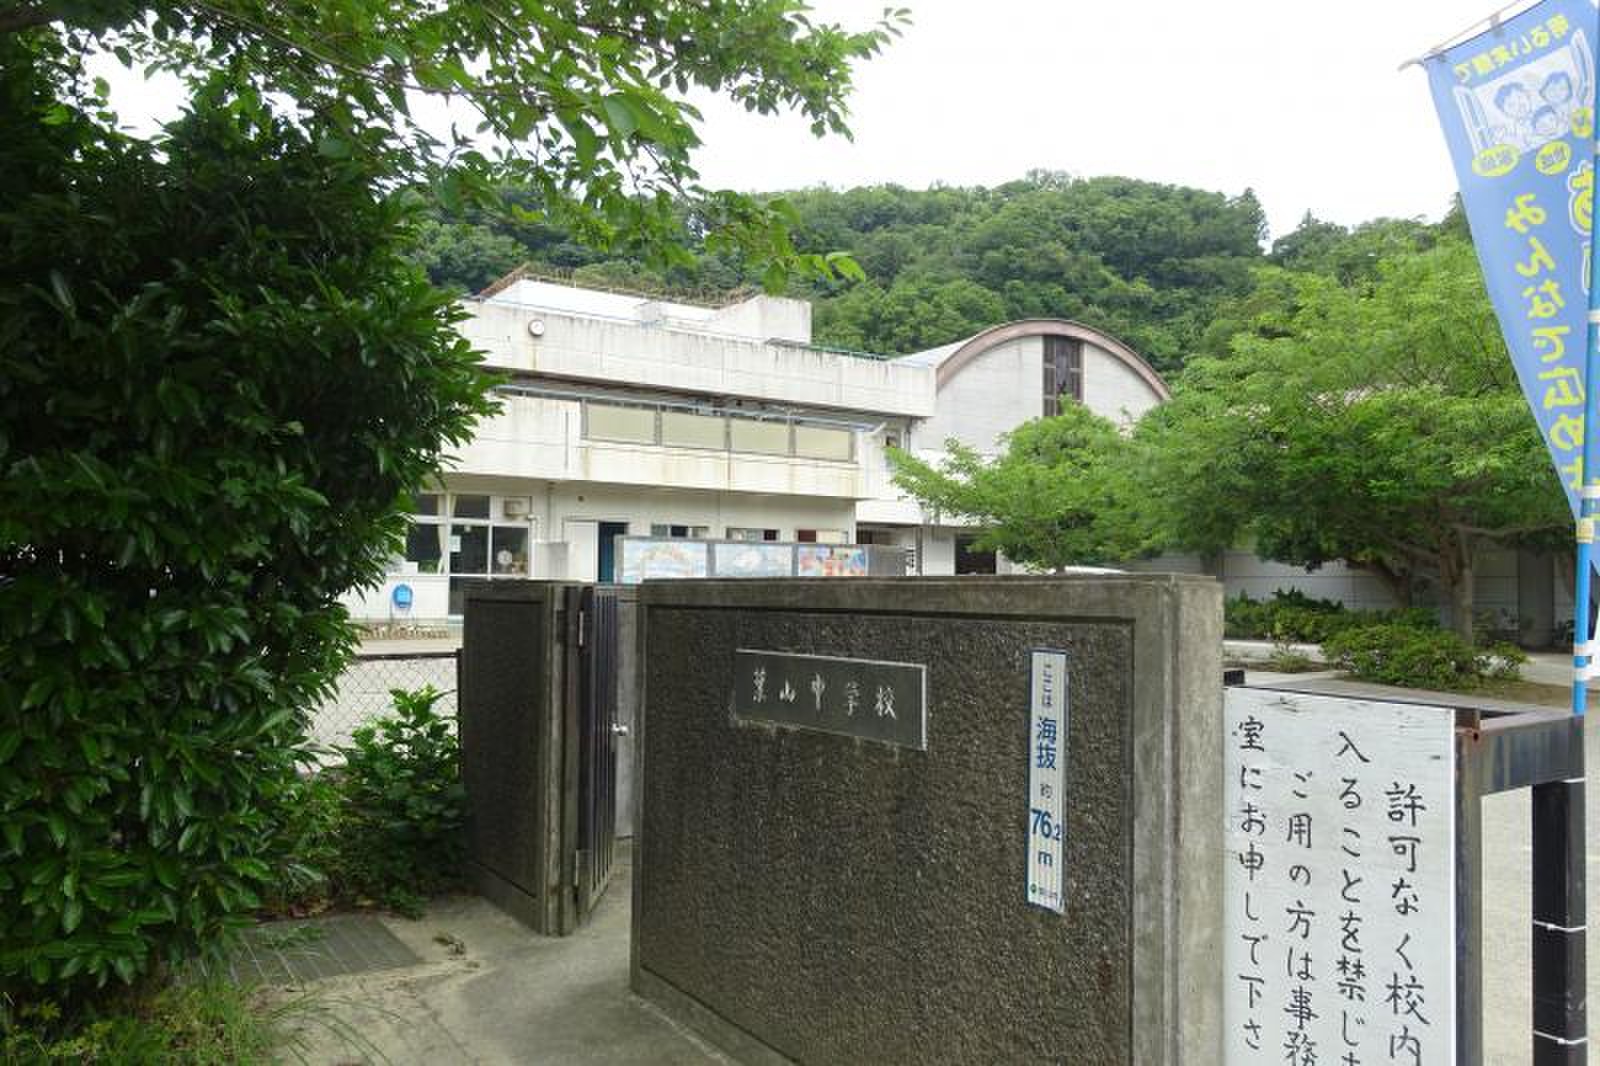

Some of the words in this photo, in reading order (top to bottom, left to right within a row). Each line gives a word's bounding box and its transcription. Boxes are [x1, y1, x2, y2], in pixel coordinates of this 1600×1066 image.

[752, 666, 896, 720] 葉山中学校
[1036, 715, 1057, 771] 海抜
[1384, 782, 1430, 1066] 許可なく校内
